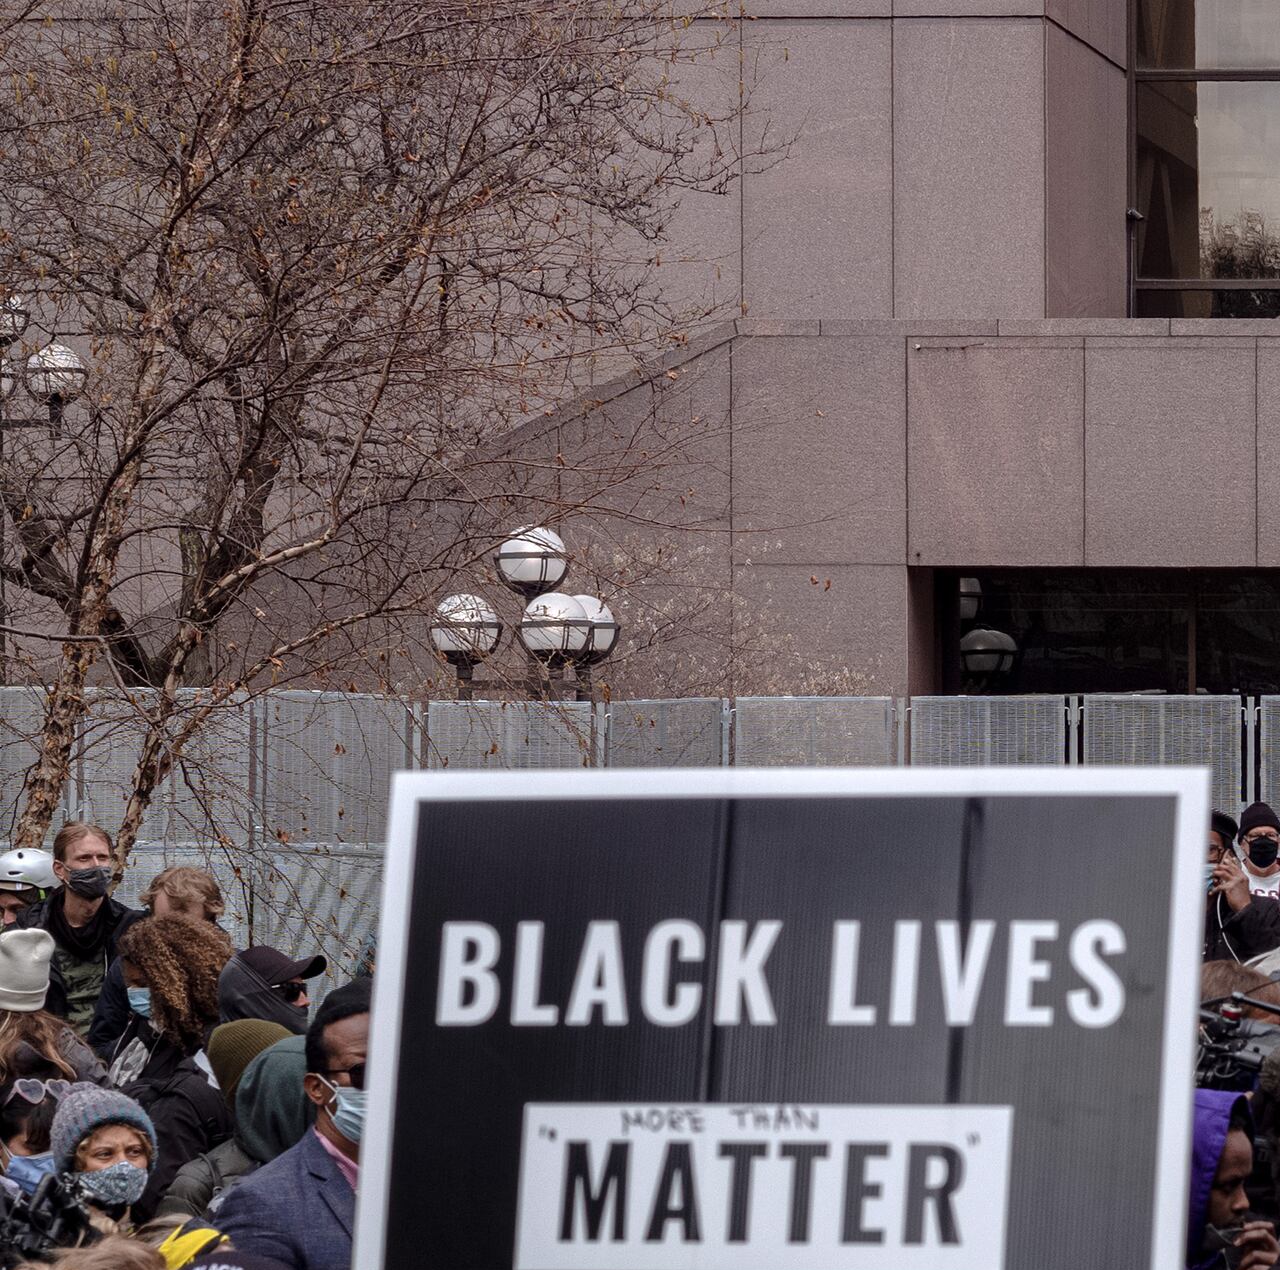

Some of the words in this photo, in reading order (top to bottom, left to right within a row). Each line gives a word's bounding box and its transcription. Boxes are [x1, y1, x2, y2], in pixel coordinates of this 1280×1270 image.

[435, 919, 784, 1027] BLACK
[828, 919, 1128, 1028] LIVES
[620, 1108, 707, 1135] MORE
[730, 1106, 821, 1133] THAN
